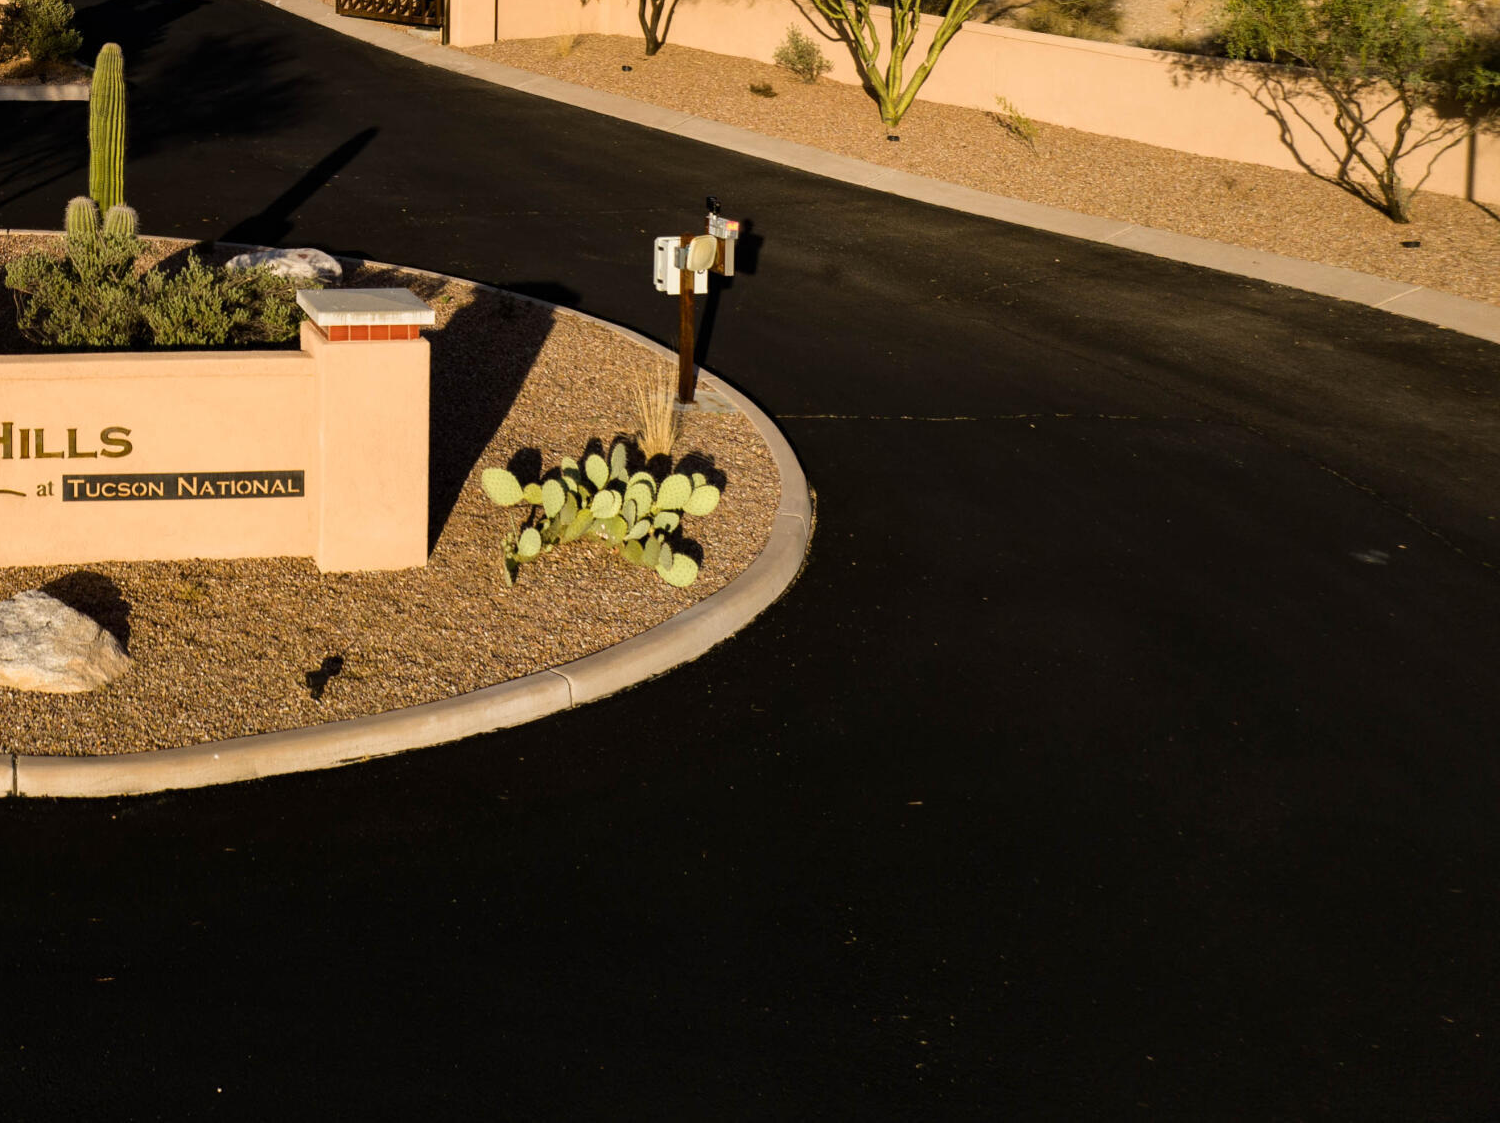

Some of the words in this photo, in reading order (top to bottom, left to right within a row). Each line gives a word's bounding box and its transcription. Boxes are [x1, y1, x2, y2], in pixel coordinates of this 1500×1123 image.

[36, 480, 55, 497] at
[67, 478, 165, 498] TUCSON
[177, 475, 301, 496] NATIONAL
